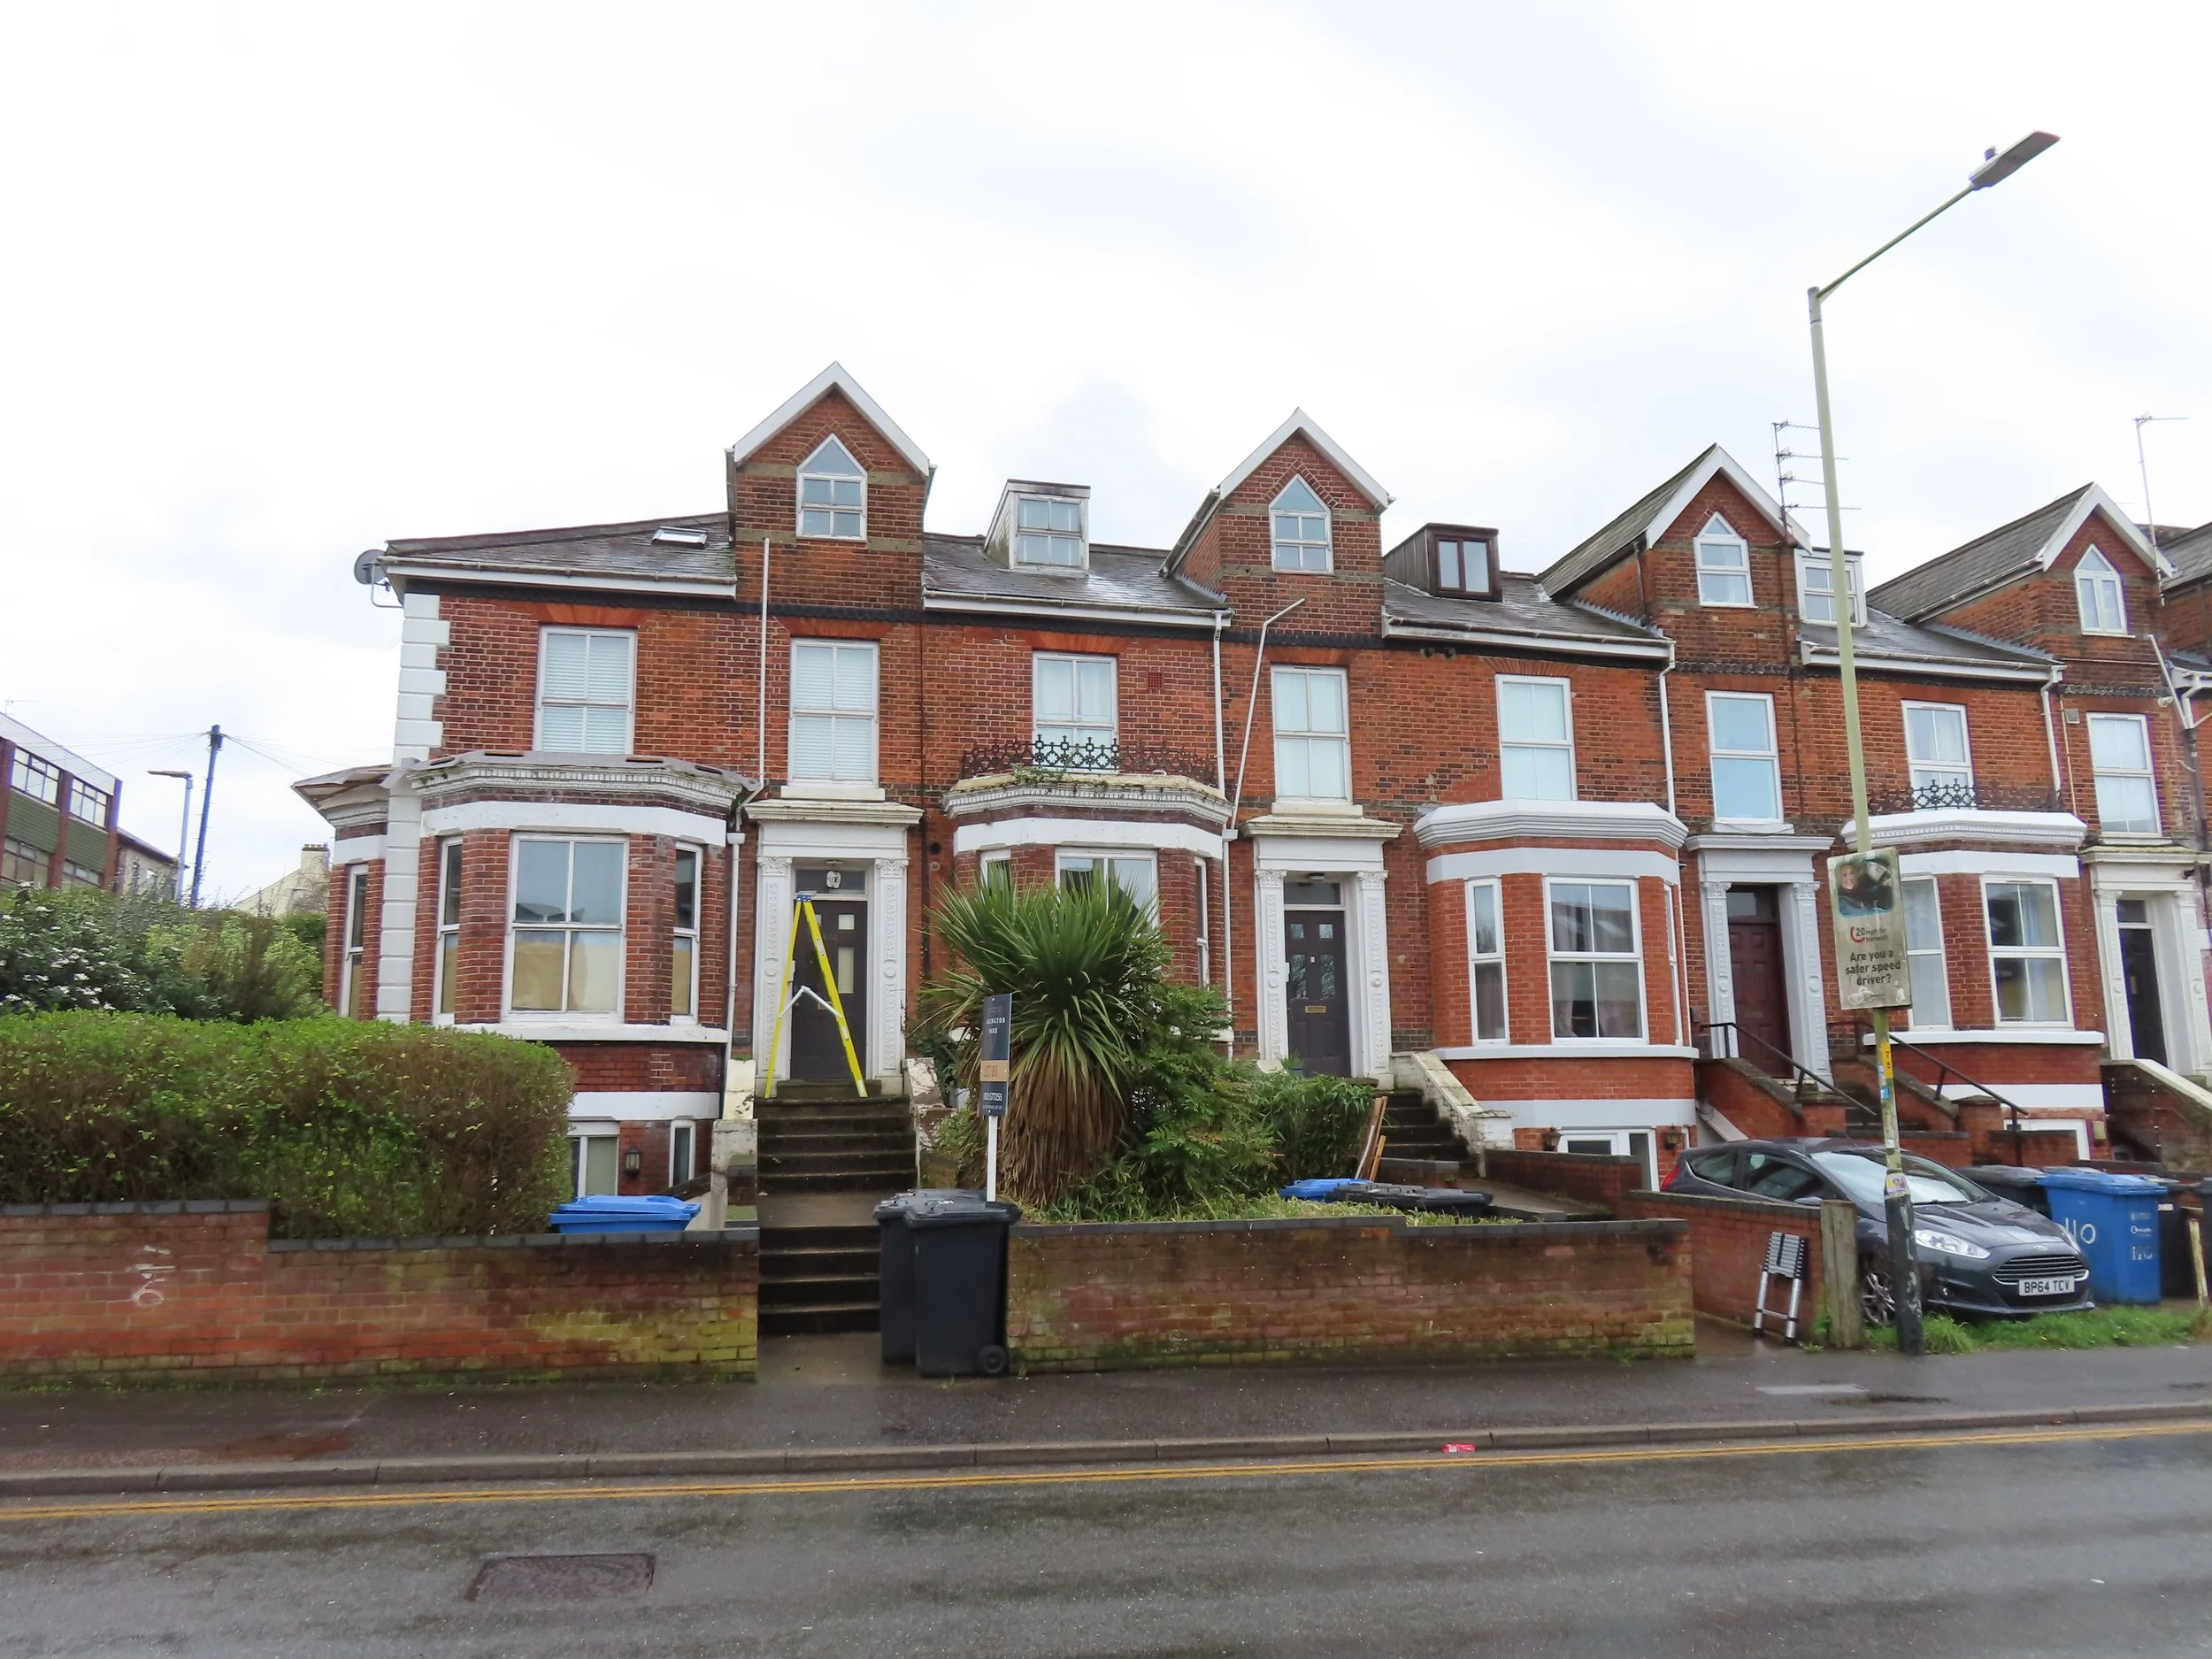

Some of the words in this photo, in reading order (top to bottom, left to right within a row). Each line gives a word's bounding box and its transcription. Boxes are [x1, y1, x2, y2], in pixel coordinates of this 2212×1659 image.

[1850, 952, 1867, 962] Are
[1870, 951, 1886, 962] you
[1846, 964, 1870, 975] safer
[1871, 961, 1901, 973] speed
[1856, 973, 1892, 986] driver?
[2024, 1281, 2050, 1293] BP64
[2053, 1280, 2070, 1291] TCV
